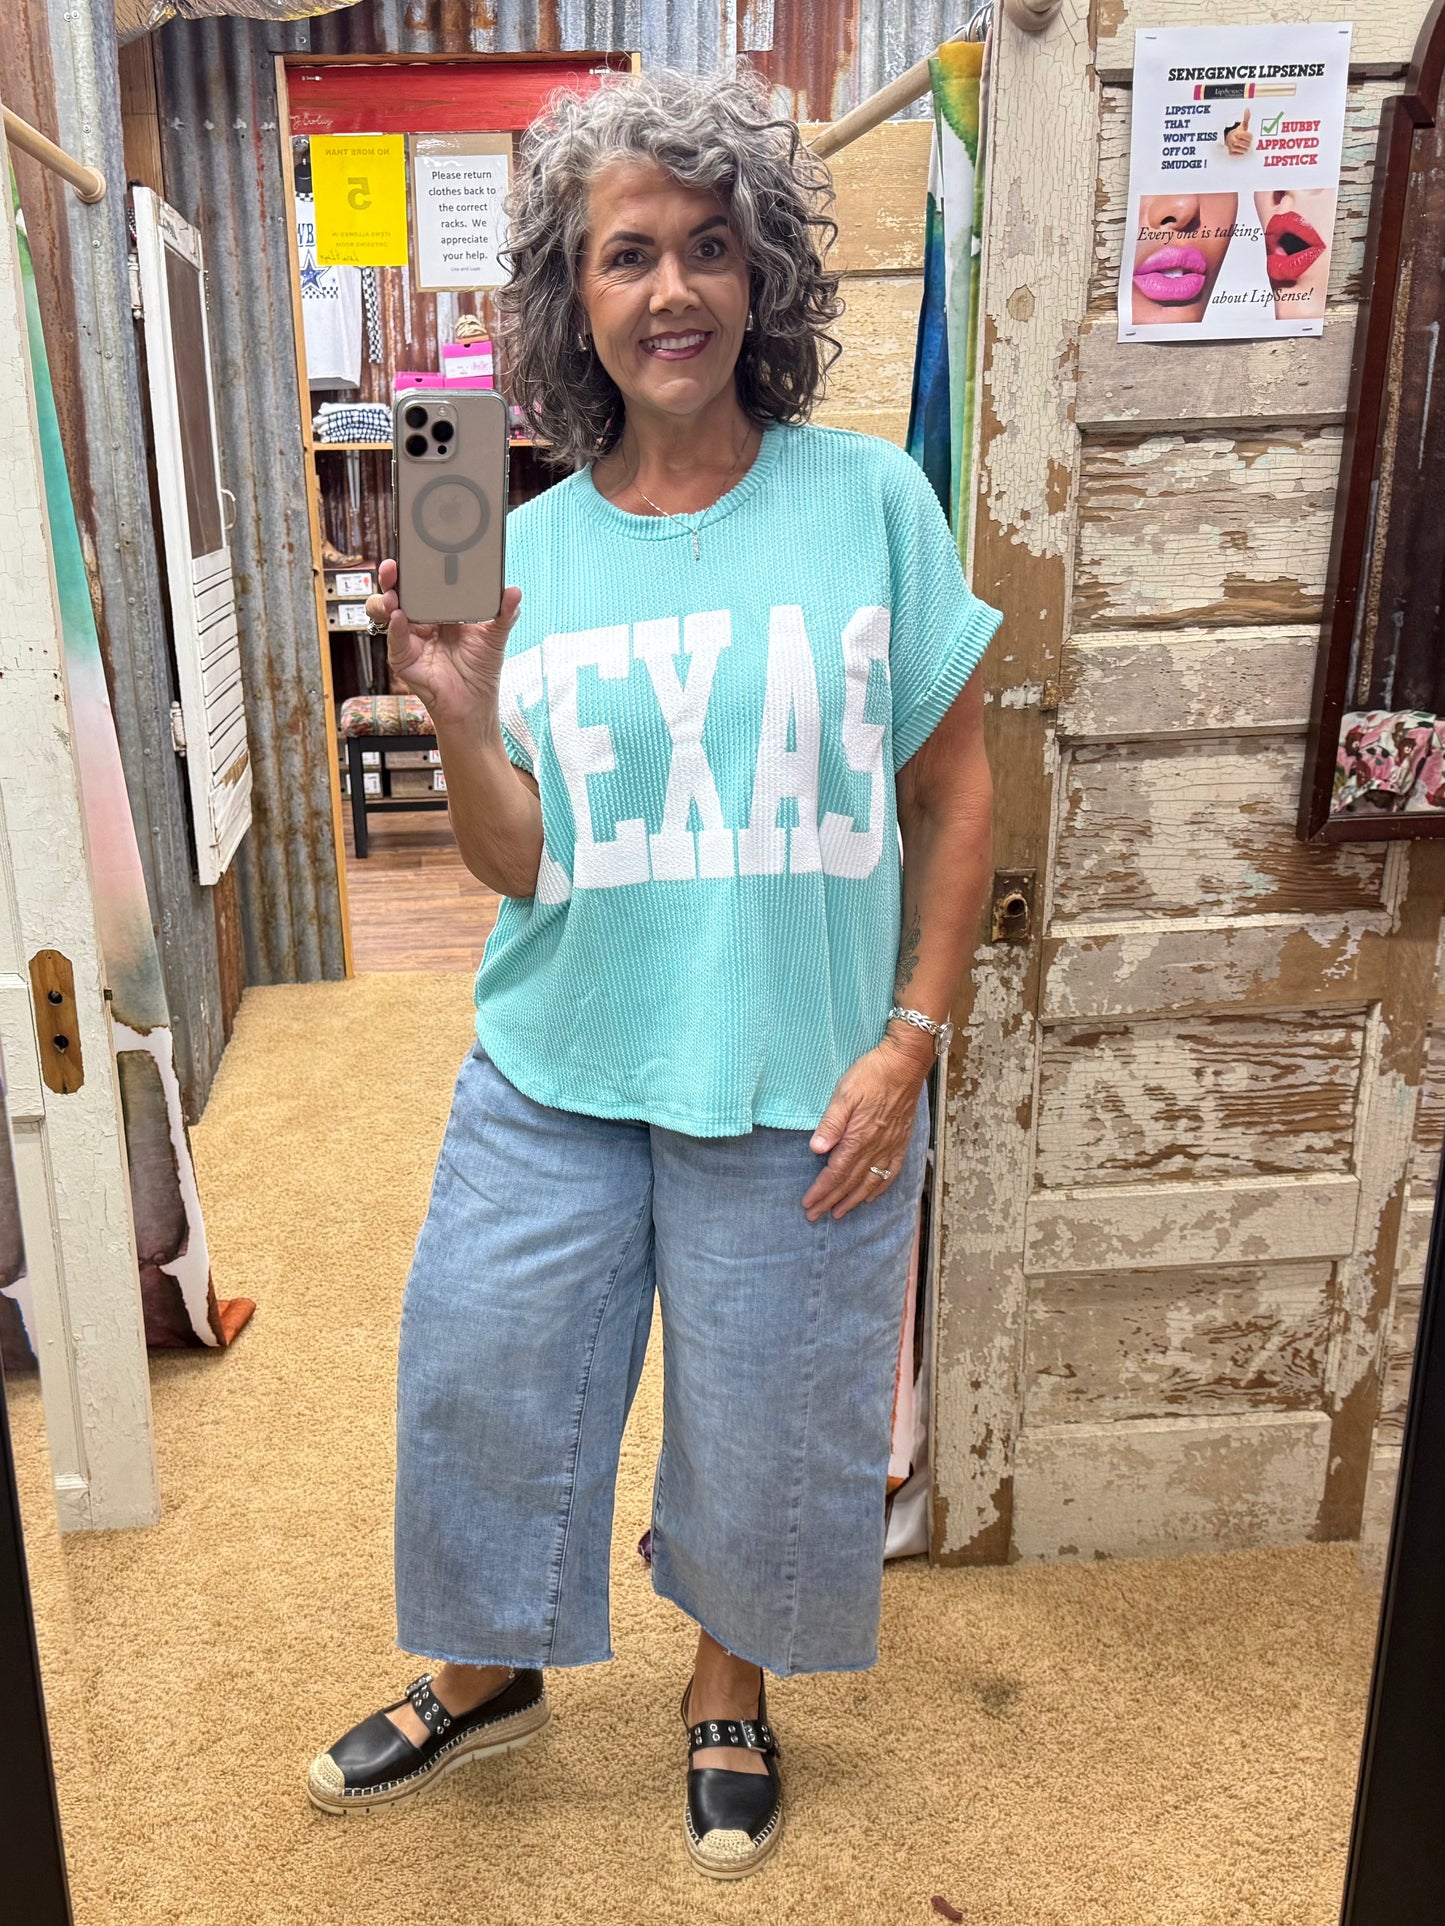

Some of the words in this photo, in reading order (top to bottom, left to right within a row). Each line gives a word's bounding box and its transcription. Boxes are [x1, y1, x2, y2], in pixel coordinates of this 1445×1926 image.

[1168, 66, 1257, 81] SENEGENCE
[1258, 63, 1325, 79] LIPSENSE
[1165, 105, 1211, 116] LIPSTICK
[1164, 119, 1191, 129] THAT
[1281, 120, 1321, 133] HUBBY
[1163, 133, 1196, 143] WON'T
[1196, 132, 1218, 142] KISS
[1256, 137, 1320, 150] APPROVED
[1162, 147, 1182, 156] OFF
[1182, 146, 1196, 156] OR
[1264, 154, 1318, 167] LIPSTICK
[432, 171, 461, 180] Please
[463, 171, 492, 179] return
[428, 187, 461, 196] clothes
[463, 186, 485, 195] back
[487, 187, 497, 195] to
[439, 203, 454, 212] the
[456, 203, 488, 212] correct
[441, 219, 467, 228] racks.
[472, 219, 487, 227] We
[440, 235, 488, 246] appreciate
[1137, 226, 1174, 245] Every
[1176, 231, 1198, 240] one
[1201, 225, 1212, 238] is
[442, 253, 463, 262] your
[465, 251, 488, 261] help.
[1212, 290, 1249, 304] about
[1249, 287, 1314, 306] LipSense!
